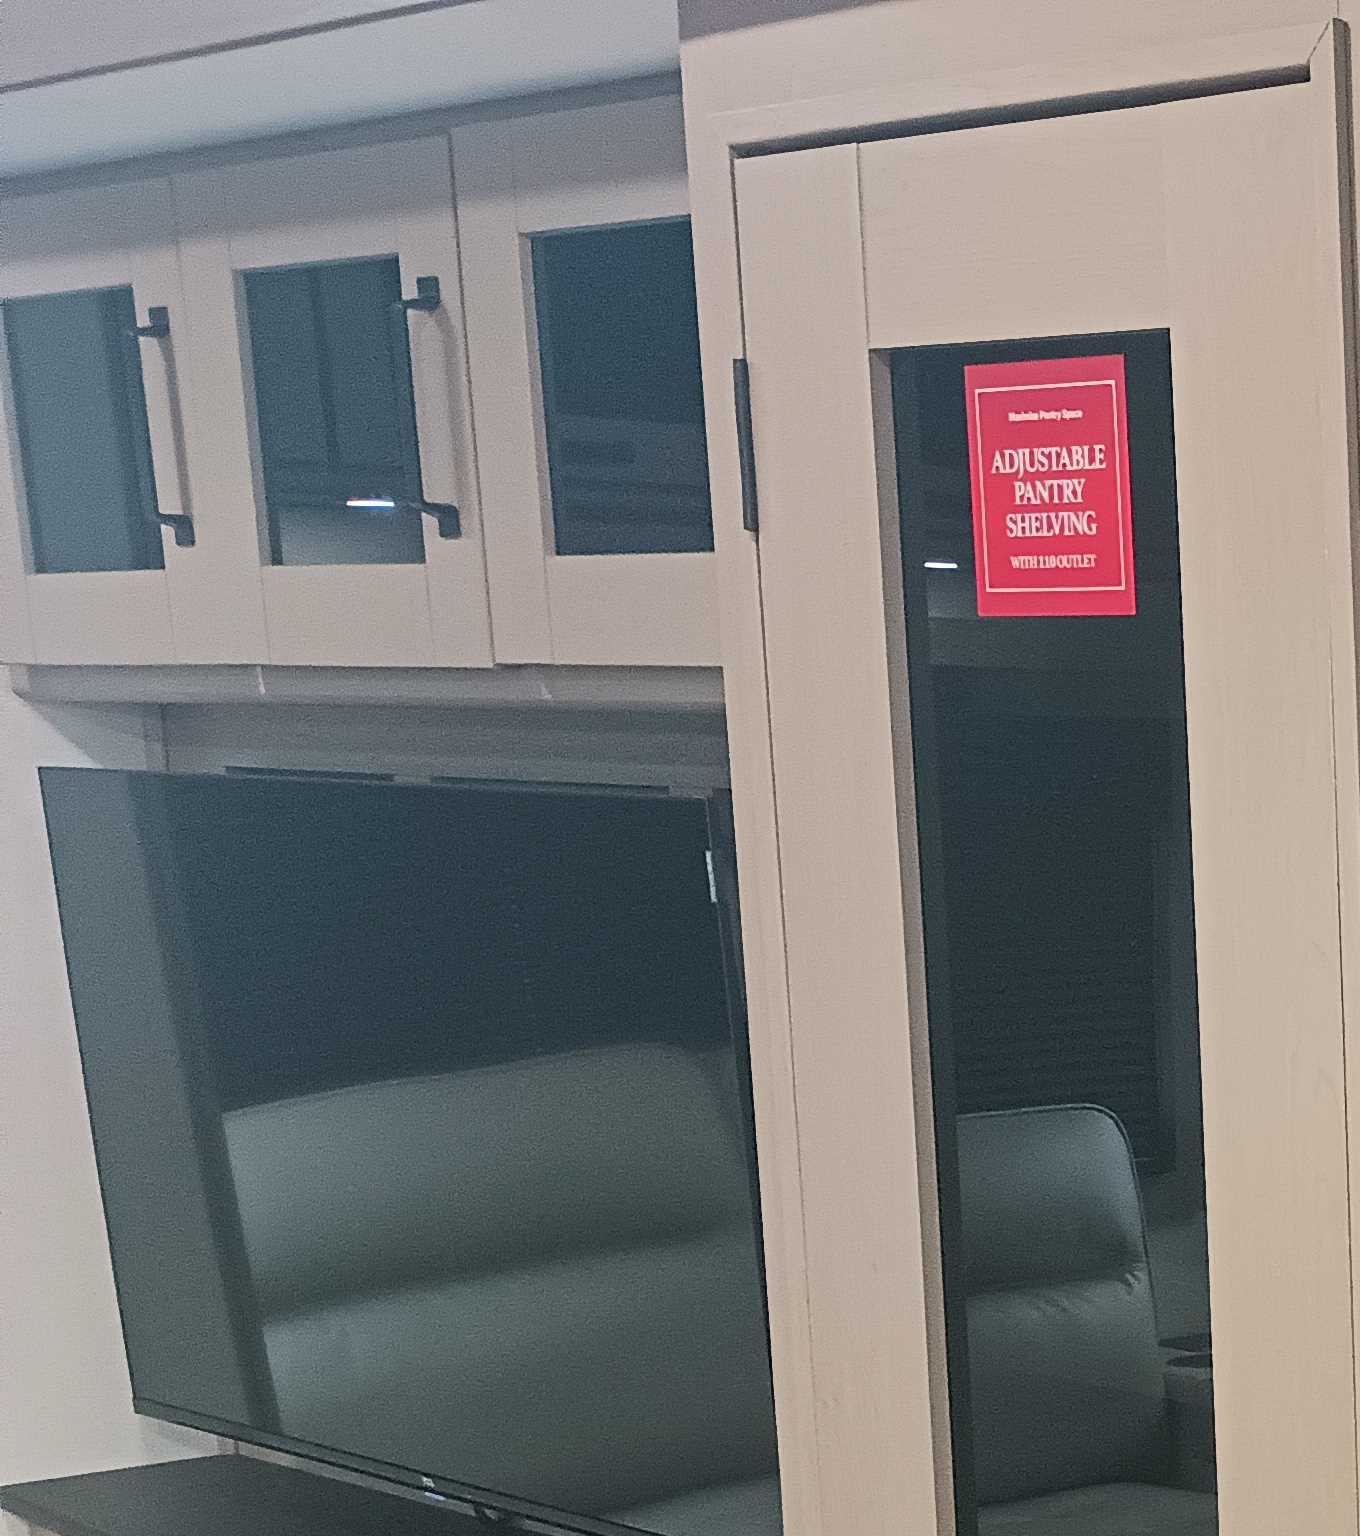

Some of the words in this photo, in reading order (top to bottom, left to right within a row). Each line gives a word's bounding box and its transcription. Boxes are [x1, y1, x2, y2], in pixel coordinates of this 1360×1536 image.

[1039, 410, 1061, 421] Pantry
[1061, 408, 1083, 421] Space
[991, 444, 1107, 479] ADJUSTABLE
[1013, 477, 1087, 505] PANTRY
[1006, 510, 1098, 538] SHELVING
[1010, 555, 1038, 569] WITH
[1038, 555, 1056, 569] 110
[1056, 553, 1097, 568] OUTLET
